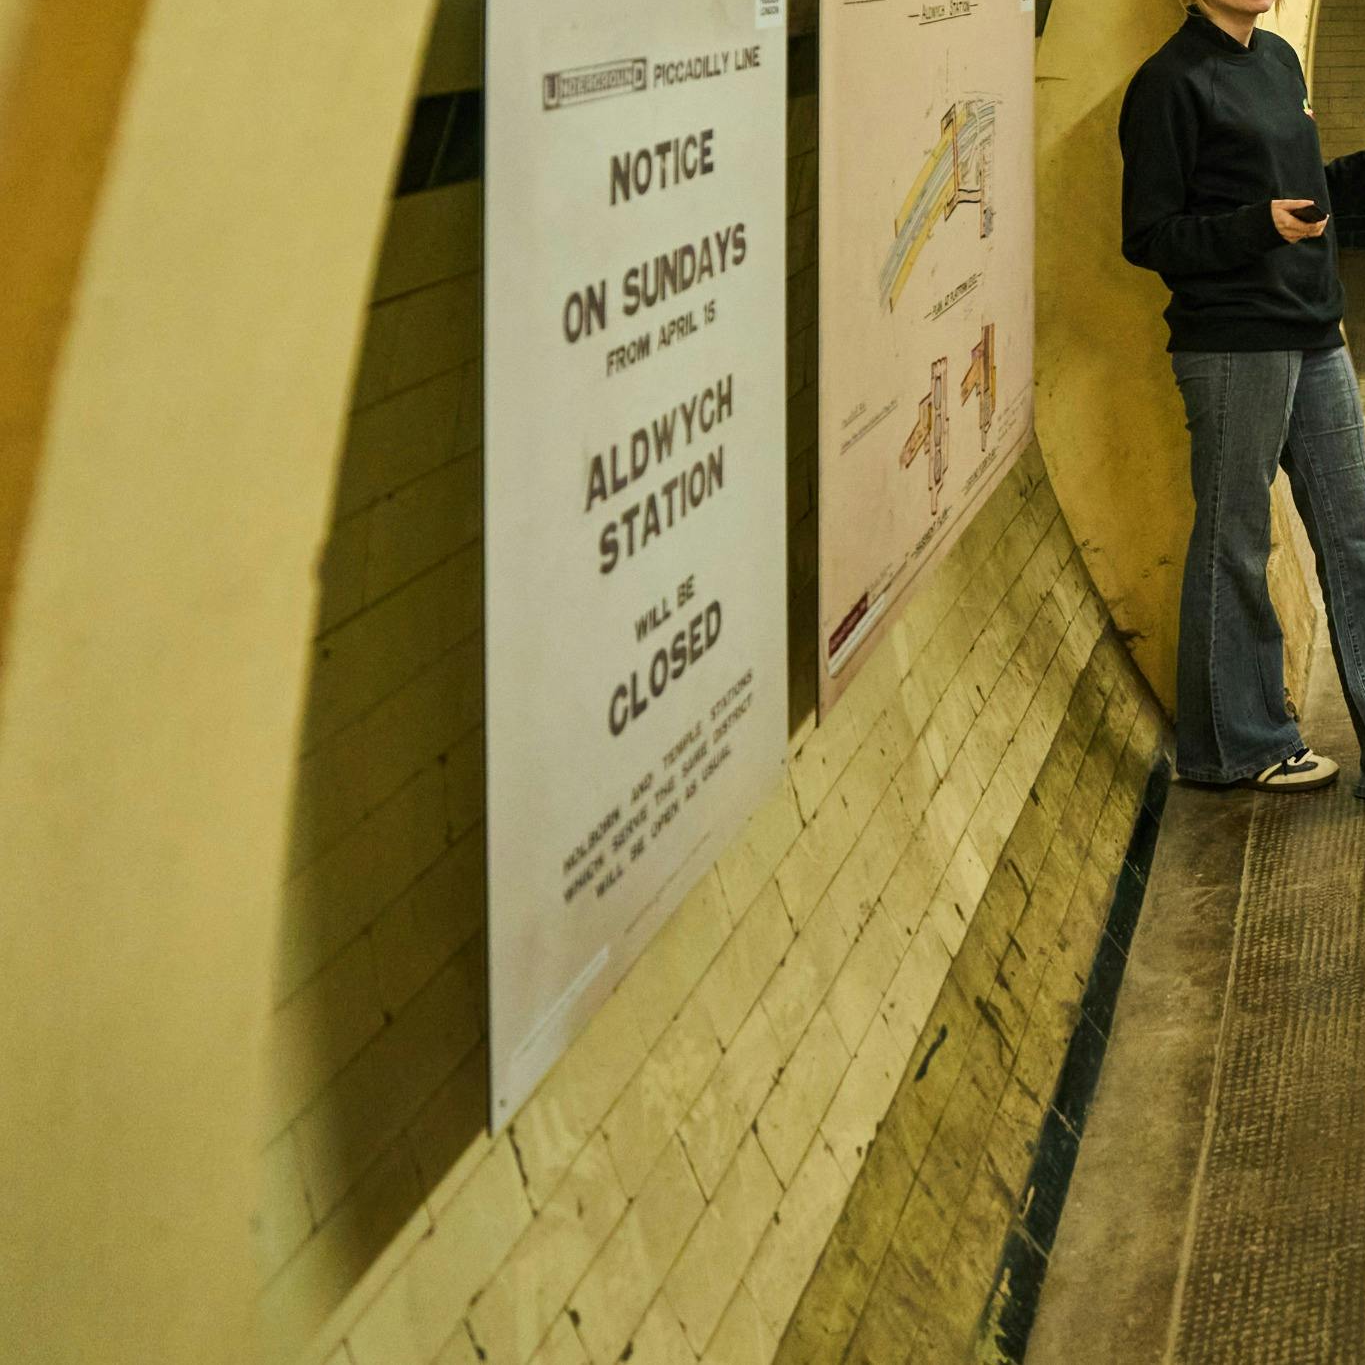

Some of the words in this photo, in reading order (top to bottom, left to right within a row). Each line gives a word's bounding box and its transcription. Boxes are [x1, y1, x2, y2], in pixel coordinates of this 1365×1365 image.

[653, 49, 730, 89] PICCADILLY
[734, 43, 761, 71] LINE
[610, 128, 715, 207] NOTICE
[563, 279, 607, 345] ON
[622, 221, 748, 318] SUNDAYS
[605, 332, 651, 378] FROM
[657, 310, 698, 351] APRIL
[703, 298, 716, 326] 15
[584, 372, 733, 513] ALDWYCH
[599, 443, 724, 575] STATION
[635, 597, 672, 643] WILL
[677, 573, 696, 609] BE
[608, 599, 722, 737] CLOSED
[631, 771, 653, 807] AND
